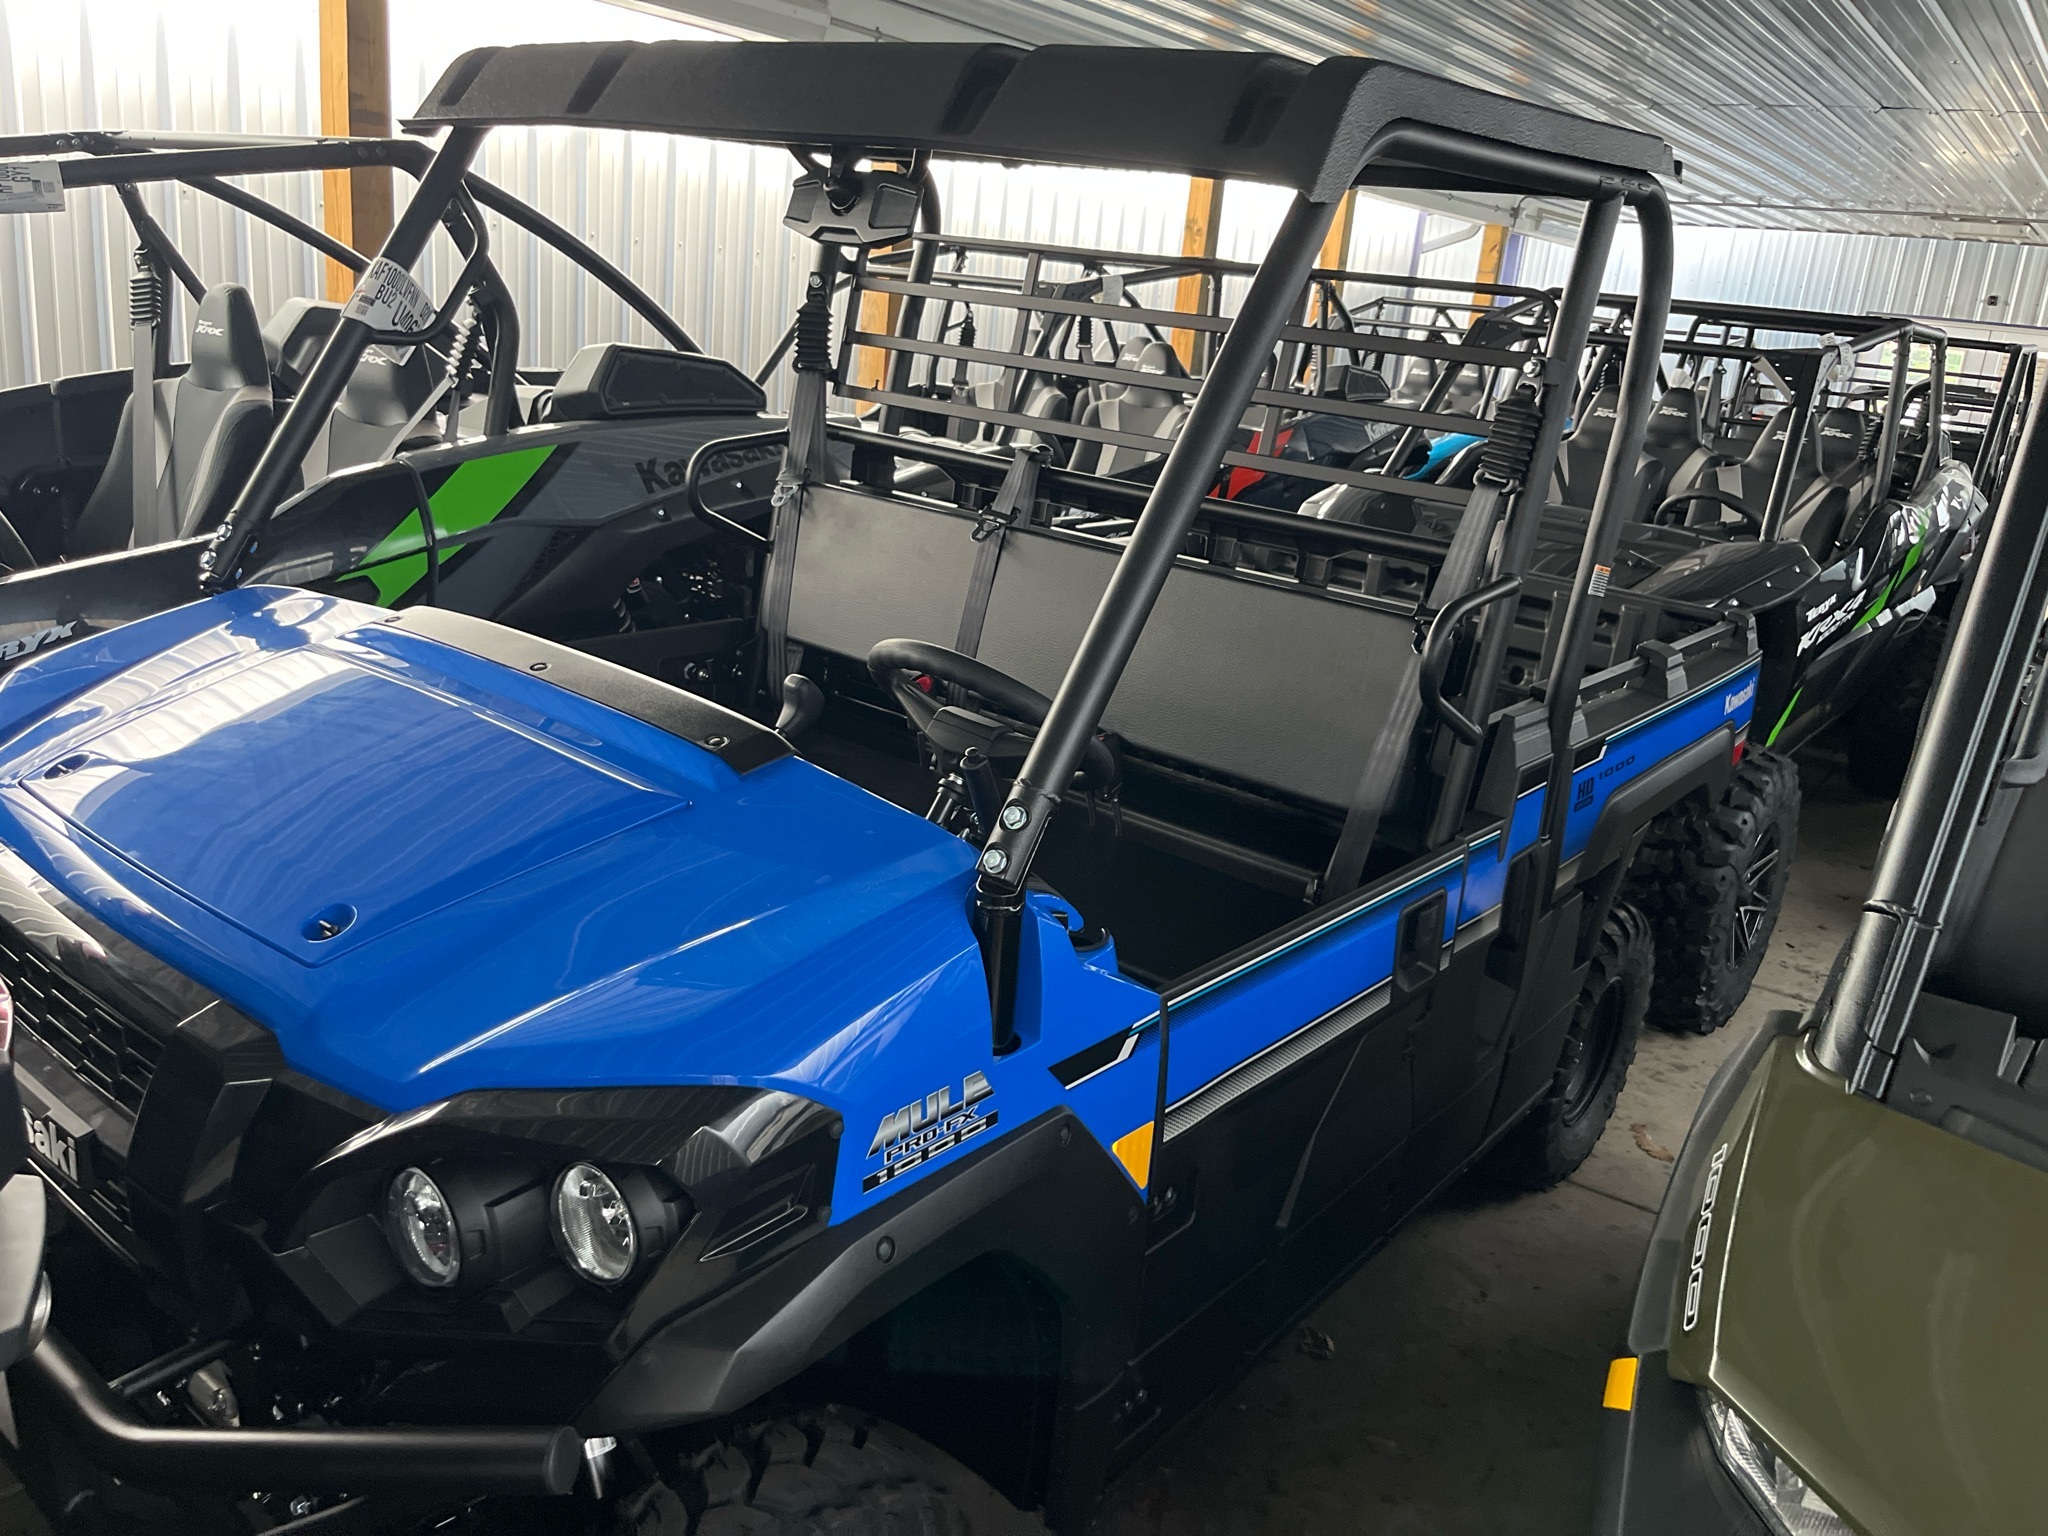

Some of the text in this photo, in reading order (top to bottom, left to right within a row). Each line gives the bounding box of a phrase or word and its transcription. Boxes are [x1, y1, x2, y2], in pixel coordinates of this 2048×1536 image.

[375, 284, 398, 309] BU2
[1576, 755, 1636, 801] HD 1000
[866, 1070, 995, 1161] MULE
[883, 1104, 980, 1166] PRO-FX
[876, 1116, 988, 1184] 1000
[1683, 1142, 1728, 1332] 1000
